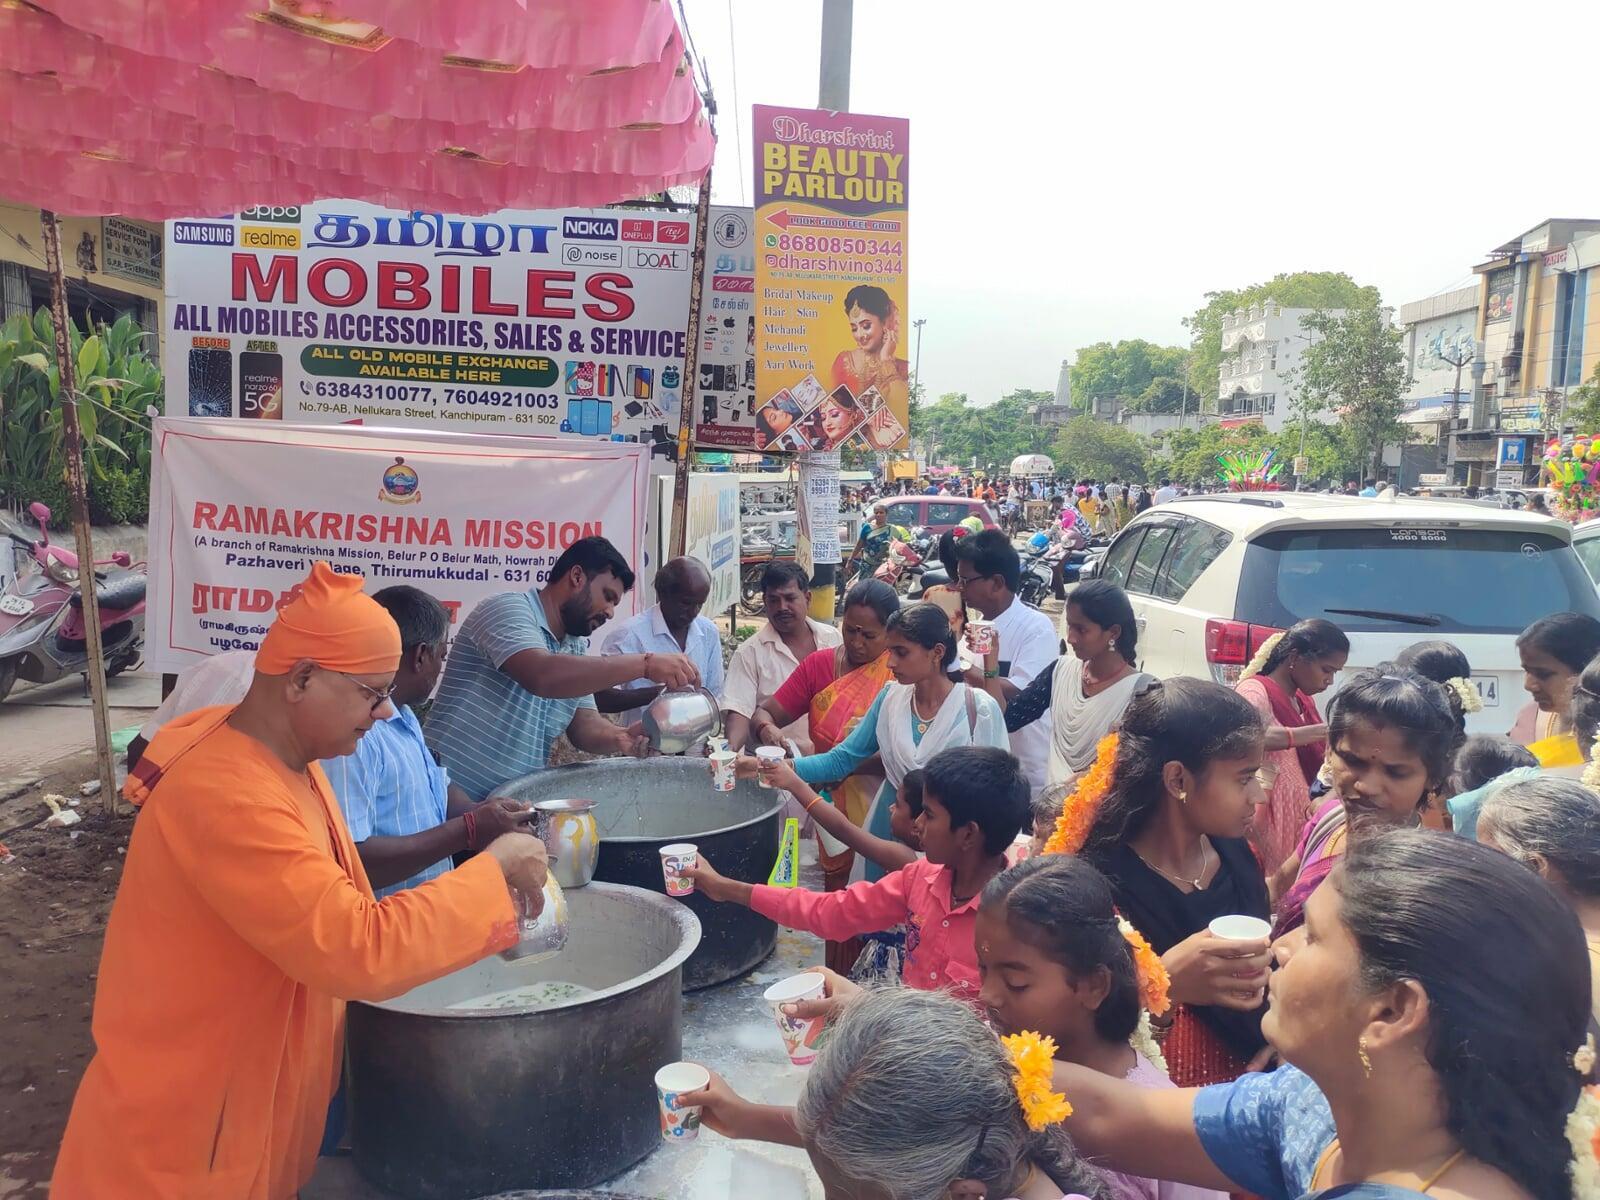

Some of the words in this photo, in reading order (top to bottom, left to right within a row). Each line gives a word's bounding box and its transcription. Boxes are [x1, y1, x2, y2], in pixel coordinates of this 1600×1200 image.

[772, 115, 895, 150] Dharshvini
[763, 143, 904, 180] BEAUTY
[763, 171, 905, 204] PARLOUR
[565, 220, 616, 236] NOKIA
[790, 216, 816, 225] LOOK
[818, 218, 845, 228] GOOD
[847, 220, 868, 229] FEEL
[872, 222, 898, 231] GOOD
[105, 227, 132, 242] SERVICE
[175, 225, 232, 243] SAMSUNG
[244, 230, 297, 247] realme
[623, 231, 653, 240] ONEPLUS
[779, 234, 903, 256] 8680850344
[231, 252, 635, 323] MOBILES
[764, 288, 793, 300] Bridal
[796, 290, 834, 303] Makeup
[764, 306, 786, 317] Hair
[797, 307, 819, 318] Skin
[174, 304, 212, 332] ALL
[217, 306, 318, 340] MOBILES
[323, 312, 489, 350] ACCESSORIES,
[494, 321, 562, 352] SALES
[568, 329, 585, 353] &
[590, 327, 686, 359] SERVICE
[764, 324, 806, 335] Mehandi
[192, 336, 231, 351] BEFORE
[246, 340, 279, 353] AFTER
[764, 341, 808, 356] Jewellery
[311, 347, 344, 360] ALL
[350, 349, 384, 362] OLD
[388, 351, 453, 366] MOBILE
[457, 355, 549, 371] EXCHANGE
[788, 359, 815, 370] Work
[244, 375, 278, 383] realme
[359, 364, 450, 380] AVAILABLE
[455, 371, 501, 383] HERE
[245, 391, 278, 412] 5G
[316, 381, 437, 406] 6384310077,
[443, 389, 559, 409] 7604921003
[299, 401, 351, 415] No.79-AB,
[354, 404, 401, 416] Nellukara
[440, 410, 506, 423] Kanchipuram
[515, 414, 533, 423] 631
[193, 501, 453, 547] RAMAKRISHNA
[464, 520, 603, 550] MISSION
[194, 536, 207, 548] (A
[211, 537, 252, 550] branch
[255, 541, 266, 551] of
[269, 541, 335, 557] Ramakrishna
[338, 547, 384, 561] Mission,
[387, 550, 416, 561] Belur
[420, 552, 427, 561] P
[430, 552, 439, 562] O
[442, 552, 470, 563] Belur
[473, 553, 502, 566] Math,
[505, 554, 545, 566] Howrah
[225, 553, 304, 570] Pazhaveri
[371, 563, 489, 582] Thirumukkudal
[504, 569, 530, 582] 631
[536, 570, 552, 583] 60
[210, 636, 260, 652] பழவே
